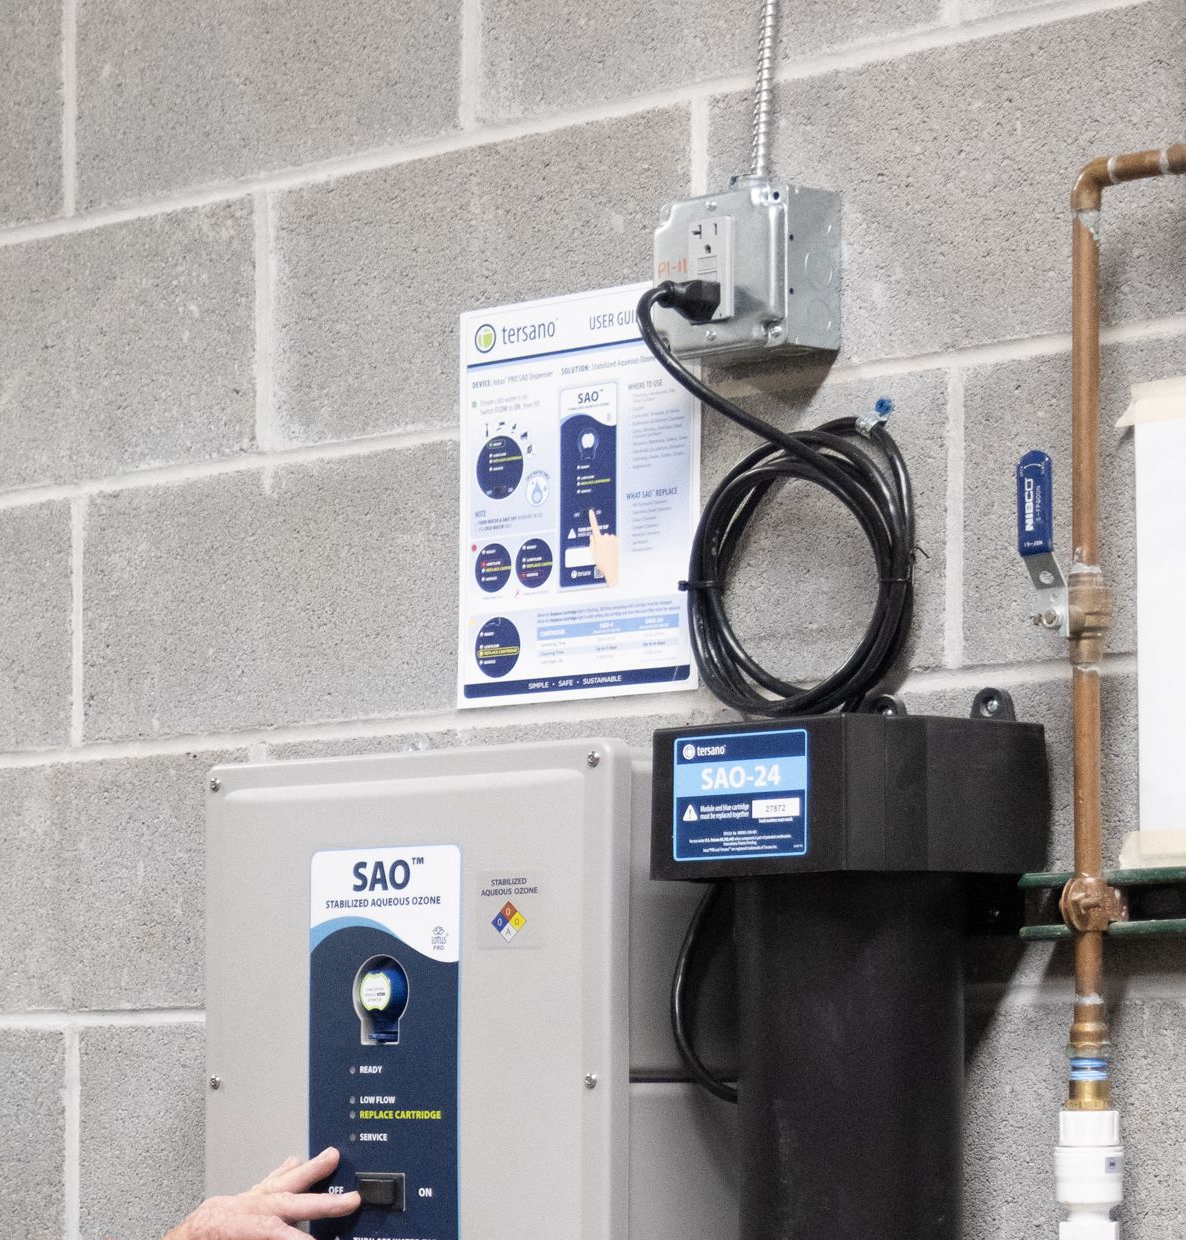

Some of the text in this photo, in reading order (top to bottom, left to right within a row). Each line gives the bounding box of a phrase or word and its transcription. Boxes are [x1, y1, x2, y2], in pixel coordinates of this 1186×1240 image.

[589, 309, 638, 331] USER GUI
[502, 321, 556, 345] tersano
[1024, 478, 1034, 531] NIBCO
[528, 675, 622, 690] SIMPLE SAFE SUSTAINABLE
[701, 764, 781, 790] SAO-24
[731, 802, 749, 811] cartridge
[716, 812, 732, 820] replaced
[732, 811, 749, 819] together
[491, 877, 527, 886] STABILIZED
[481, 886, 539, 897] AQUEOUS OZONE
[325, 895, 441, 909] STABILIZED AQUEOUS OZONE
[505, 907, 511, 916] 0
[497, 918, 502, 926] 0
[360, 1065, 382, 1074] READY
[360, 1096, 396, 1104] LOW FLOW
[360, 1110, 441, 1120] REPLACE CARTRIDGE
[360, 1133, 388, 1142] SERVICE
[328, 1185, 344, 1195] OFF
[418, 1188, 432, 1197] ON
